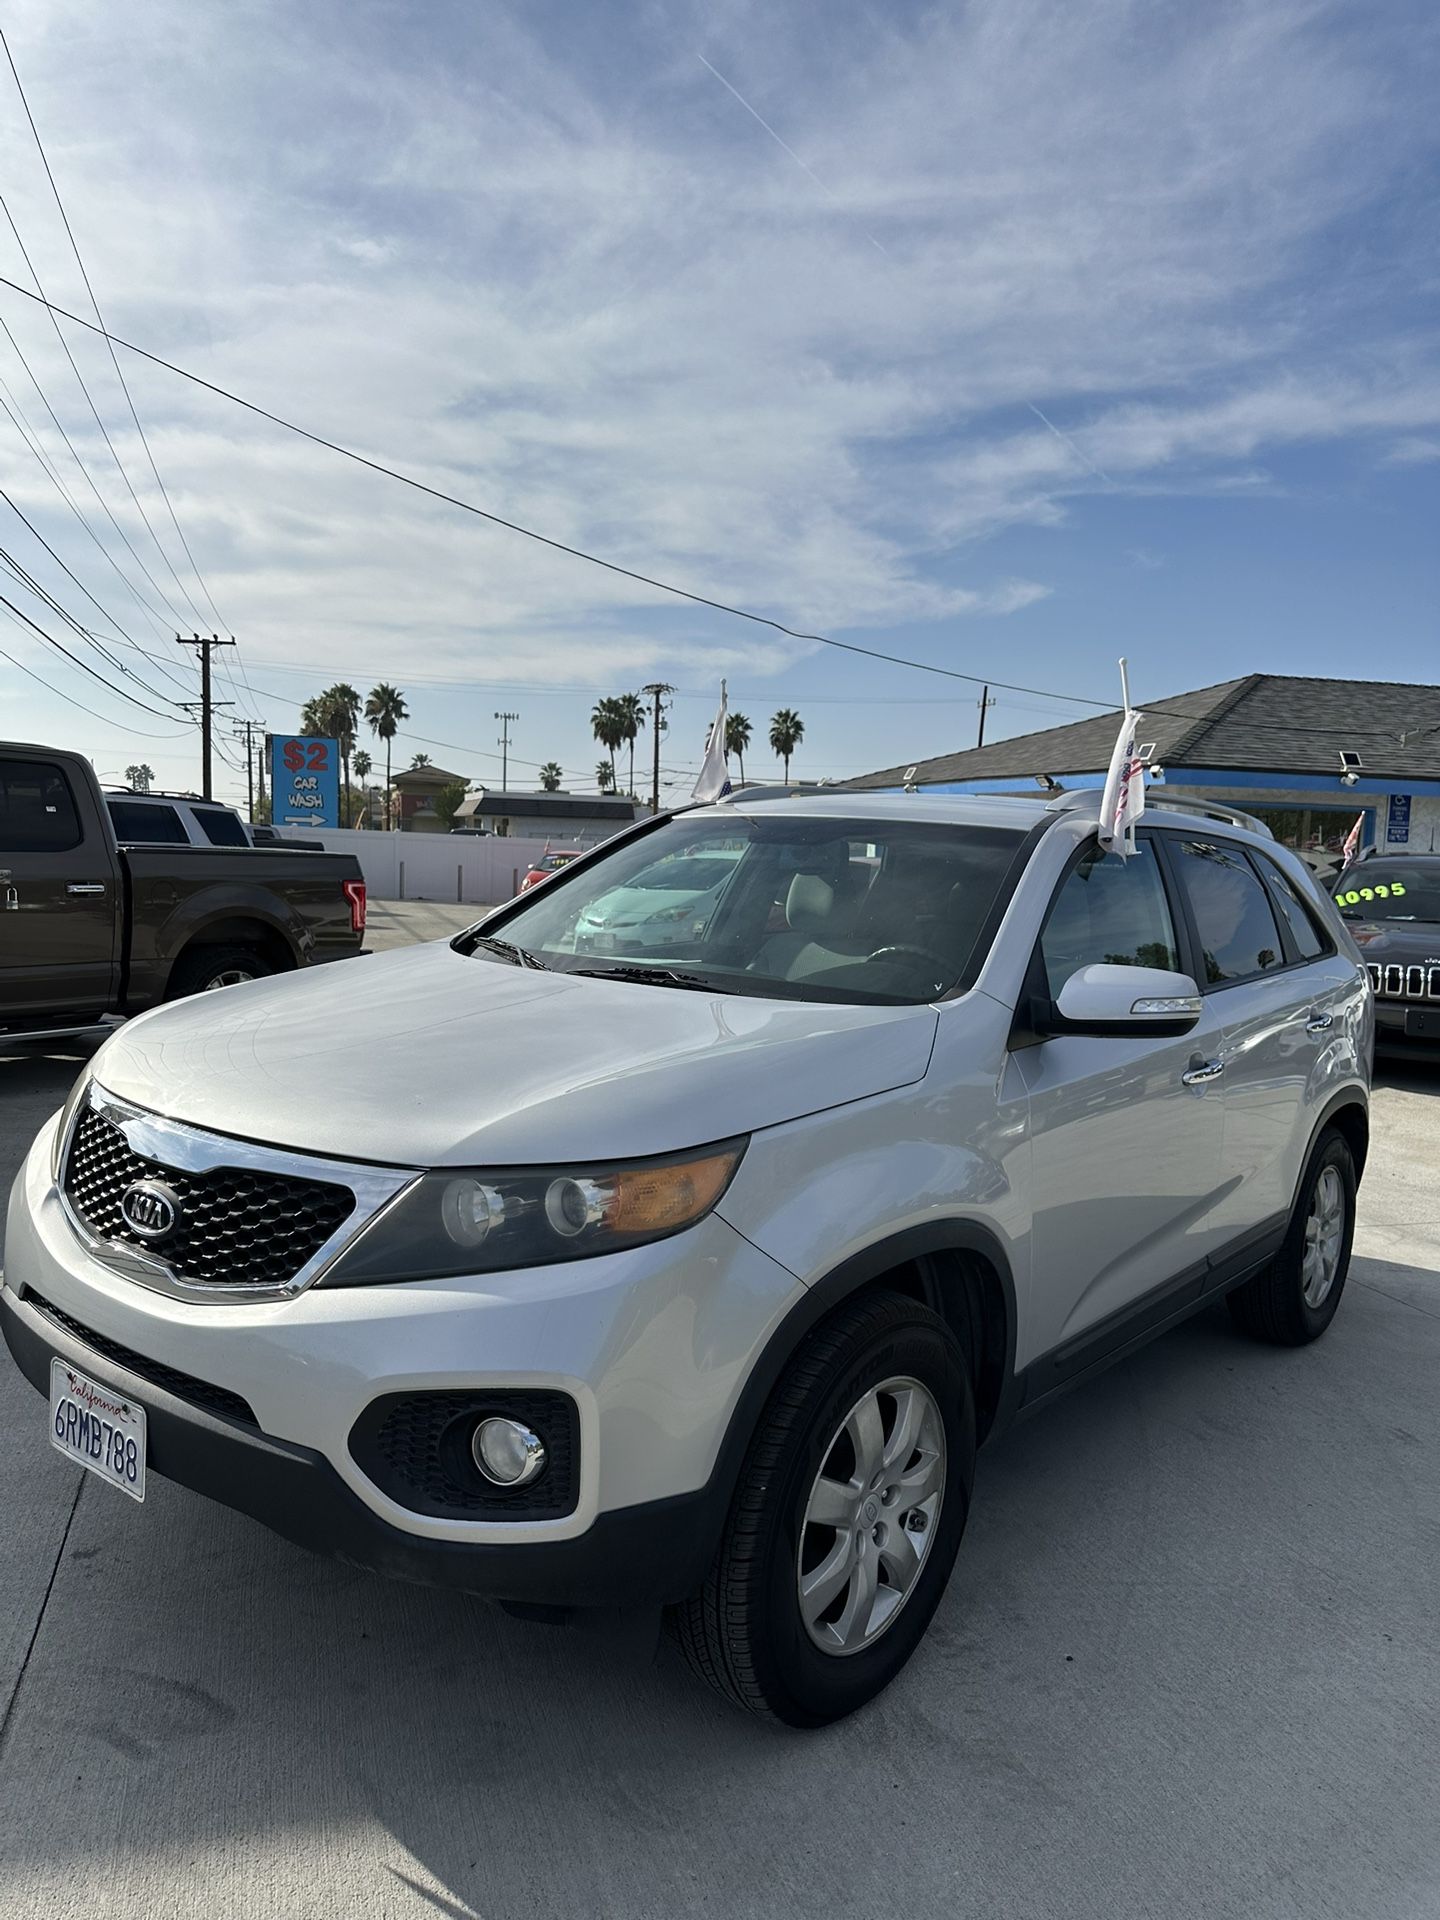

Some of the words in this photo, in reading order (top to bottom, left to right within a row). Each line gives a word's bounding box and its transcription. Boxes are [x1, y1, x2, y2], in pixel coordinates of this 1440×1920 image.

[283, 739, 329, 774] $2
[288, 793, 324, 809] WASH
[293, 776, 319, 791] CAR
[1335, 882, 1406, 907] 10995
[130, 1193, 163, 1229] KIA
[69, 1374, 126, 1422] California
[55, 1398, 138, 1483] 6RMB788
